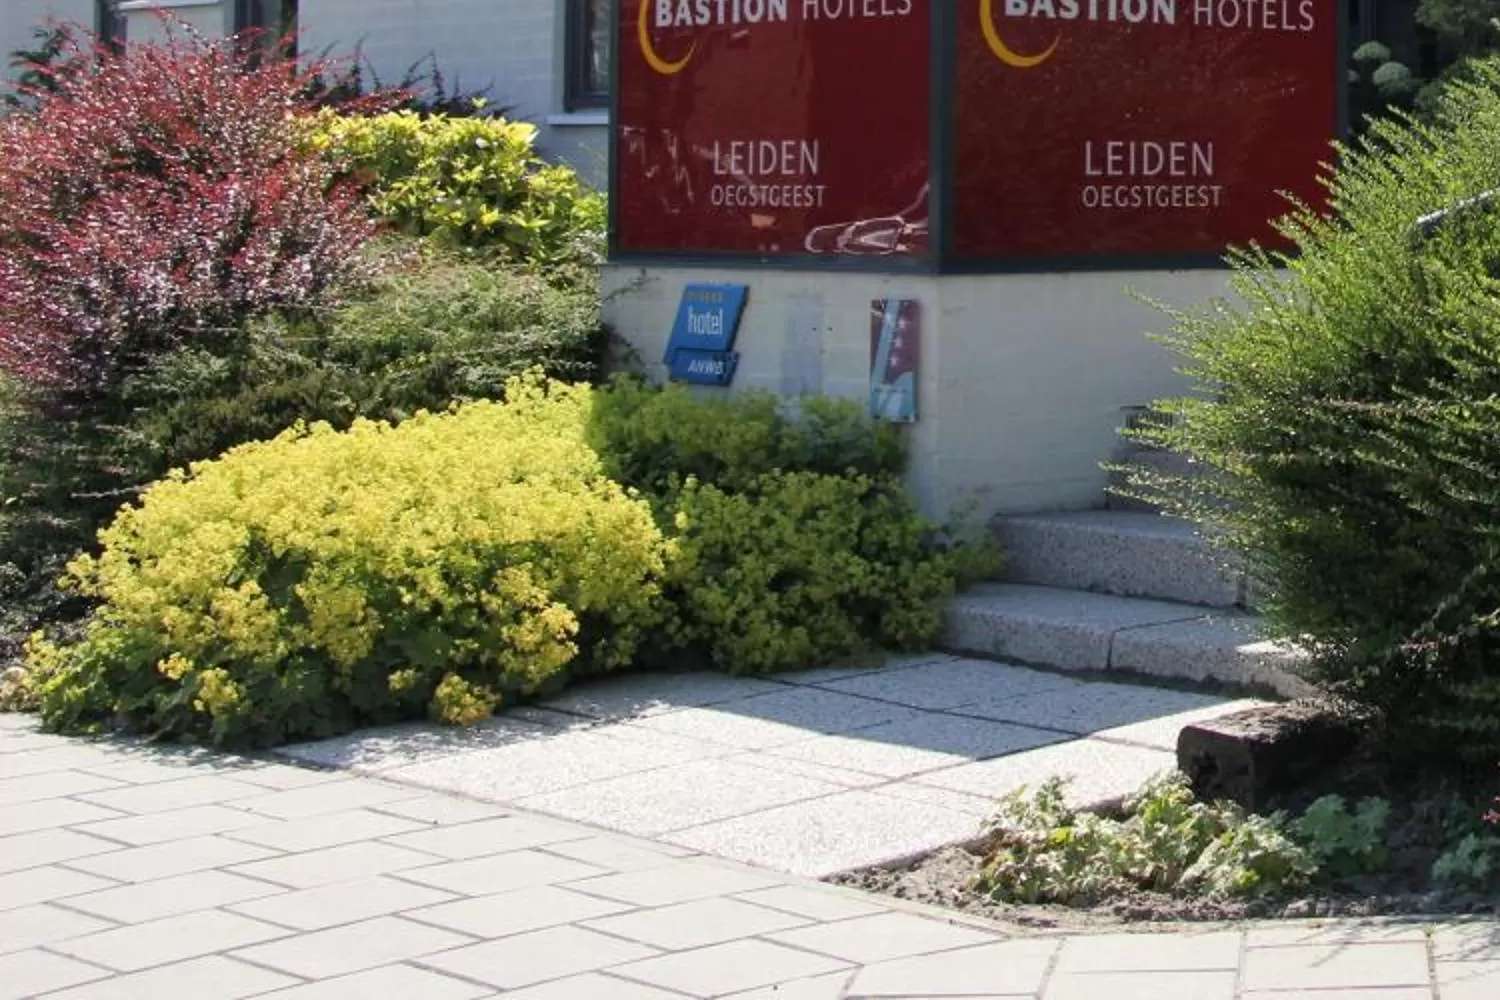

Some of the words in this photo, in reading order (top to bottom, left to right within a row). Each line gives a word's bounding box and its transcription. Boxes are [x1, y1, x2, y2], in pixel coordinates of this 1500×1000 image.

[713, 138, 820, 176] LEIDEN
[1085, 140, 1214, 177] LEIDEN
[711, 183, 828, 208] OEGSTGEEST
[1082, 184, 1223, 209] OEGSTGEEST
[687, 305, 724, 336] hotel
